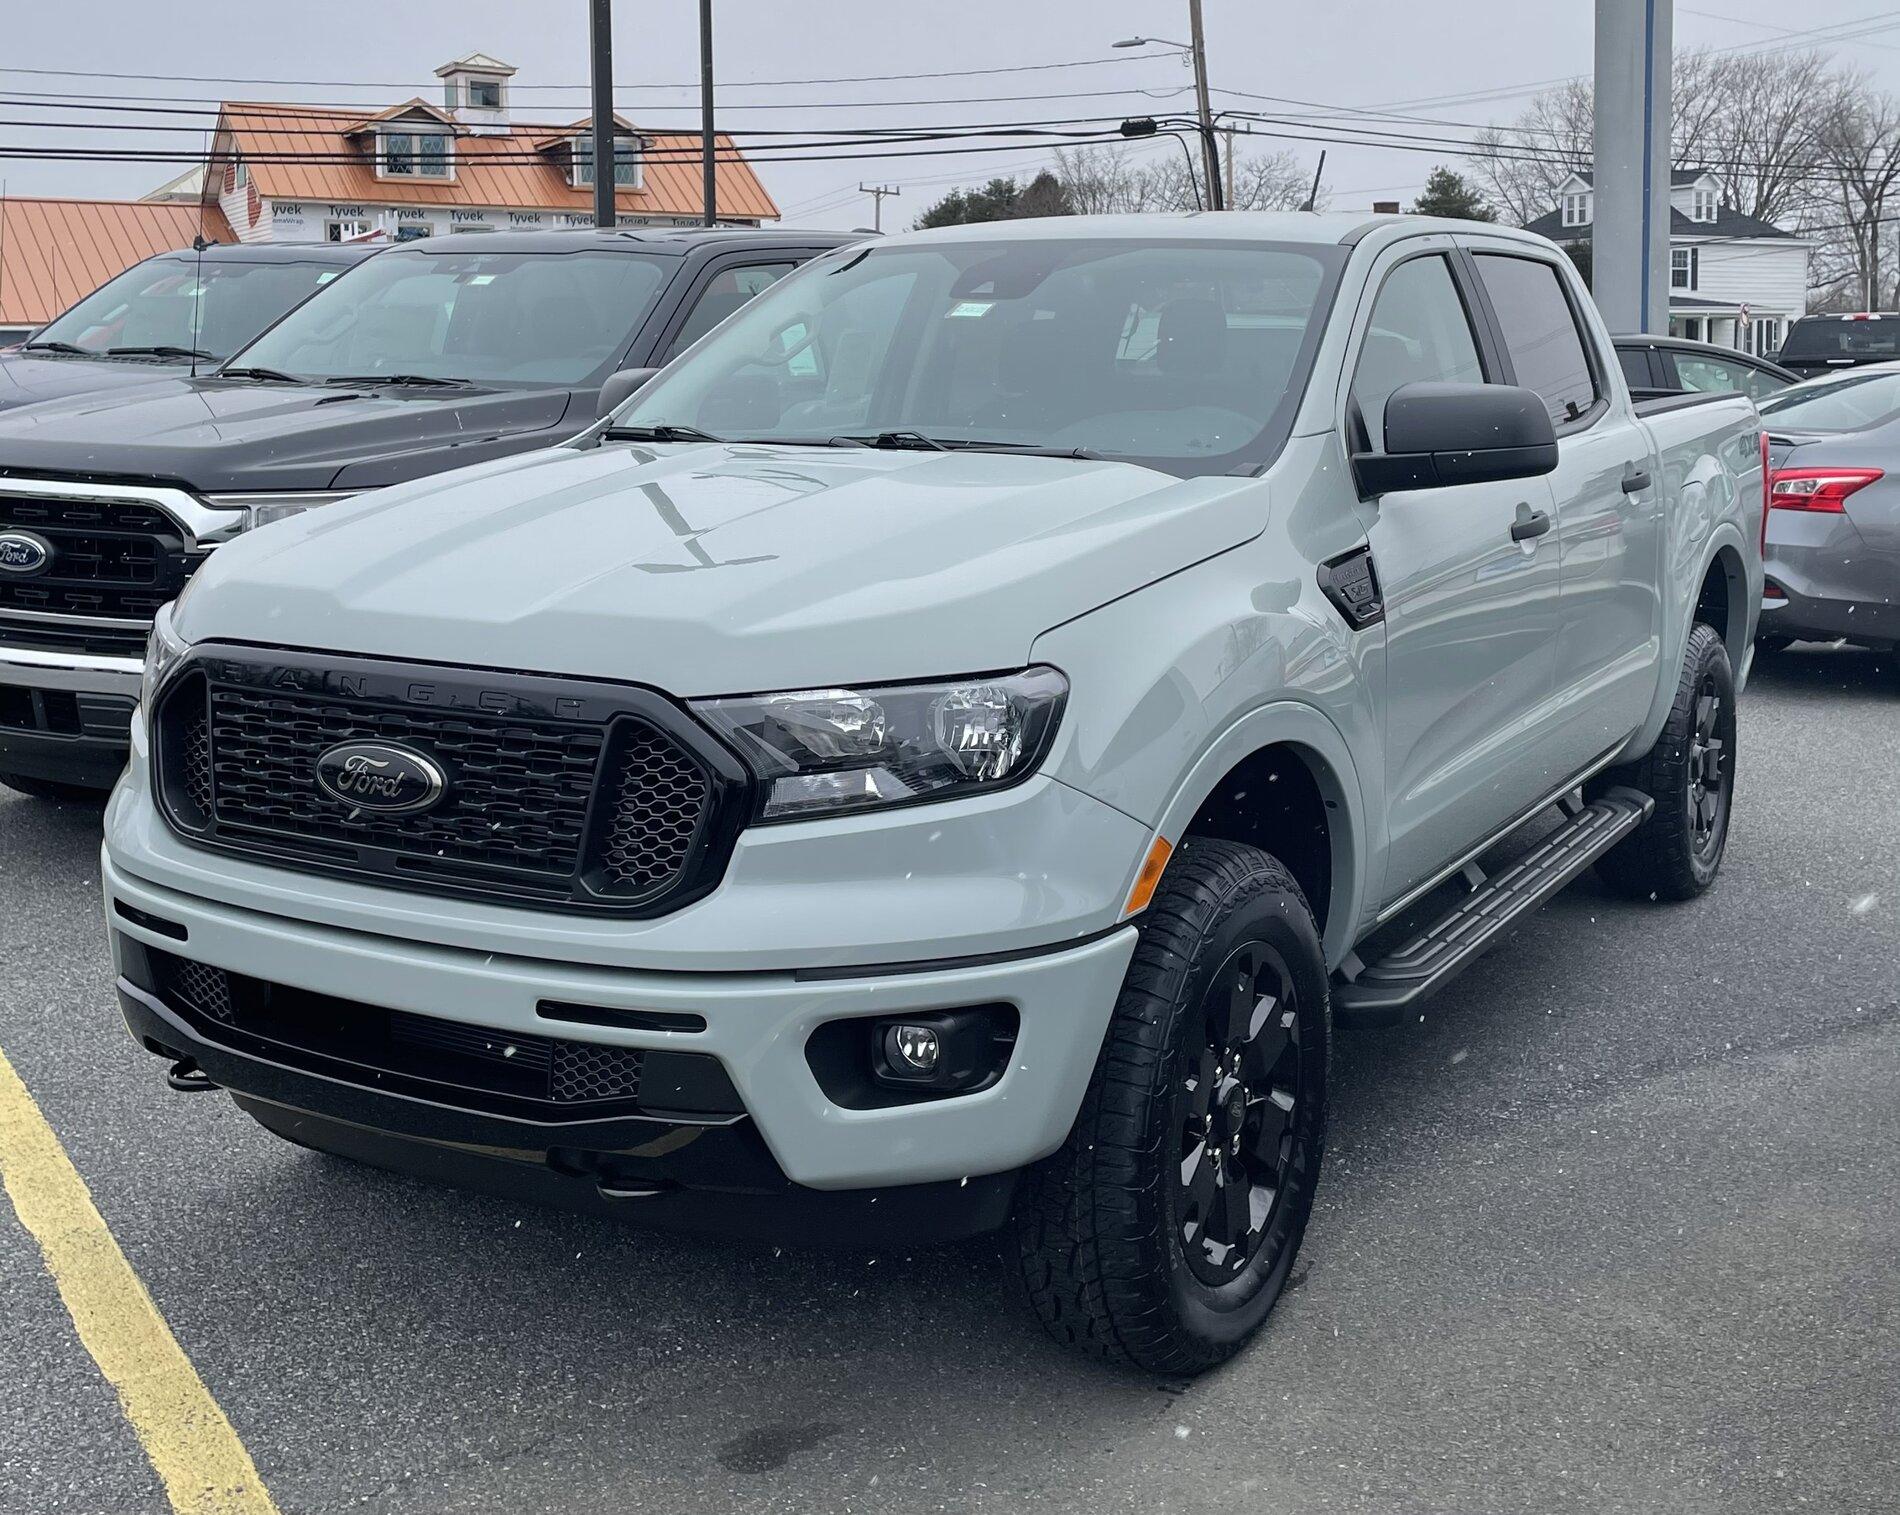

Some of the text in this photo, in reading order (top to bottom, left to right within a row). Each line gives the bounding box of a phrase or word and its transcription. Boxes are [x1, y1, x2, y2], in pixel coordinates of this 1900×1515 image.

[271, 203, 302, 217] yvek
[328, 204, 367, 219] Tyvek
[390, 207, 425, 221] Tyvek
[450, 209, 484, 223] Tyvek
[508, 211, 541, 225] Tyvek
[564, 214, 596, 228] Tyvek
[0, 541, 29, 563] Ford
[220, 662, 588, 720] RANGER
[337, 755, 405, 798] Ford
